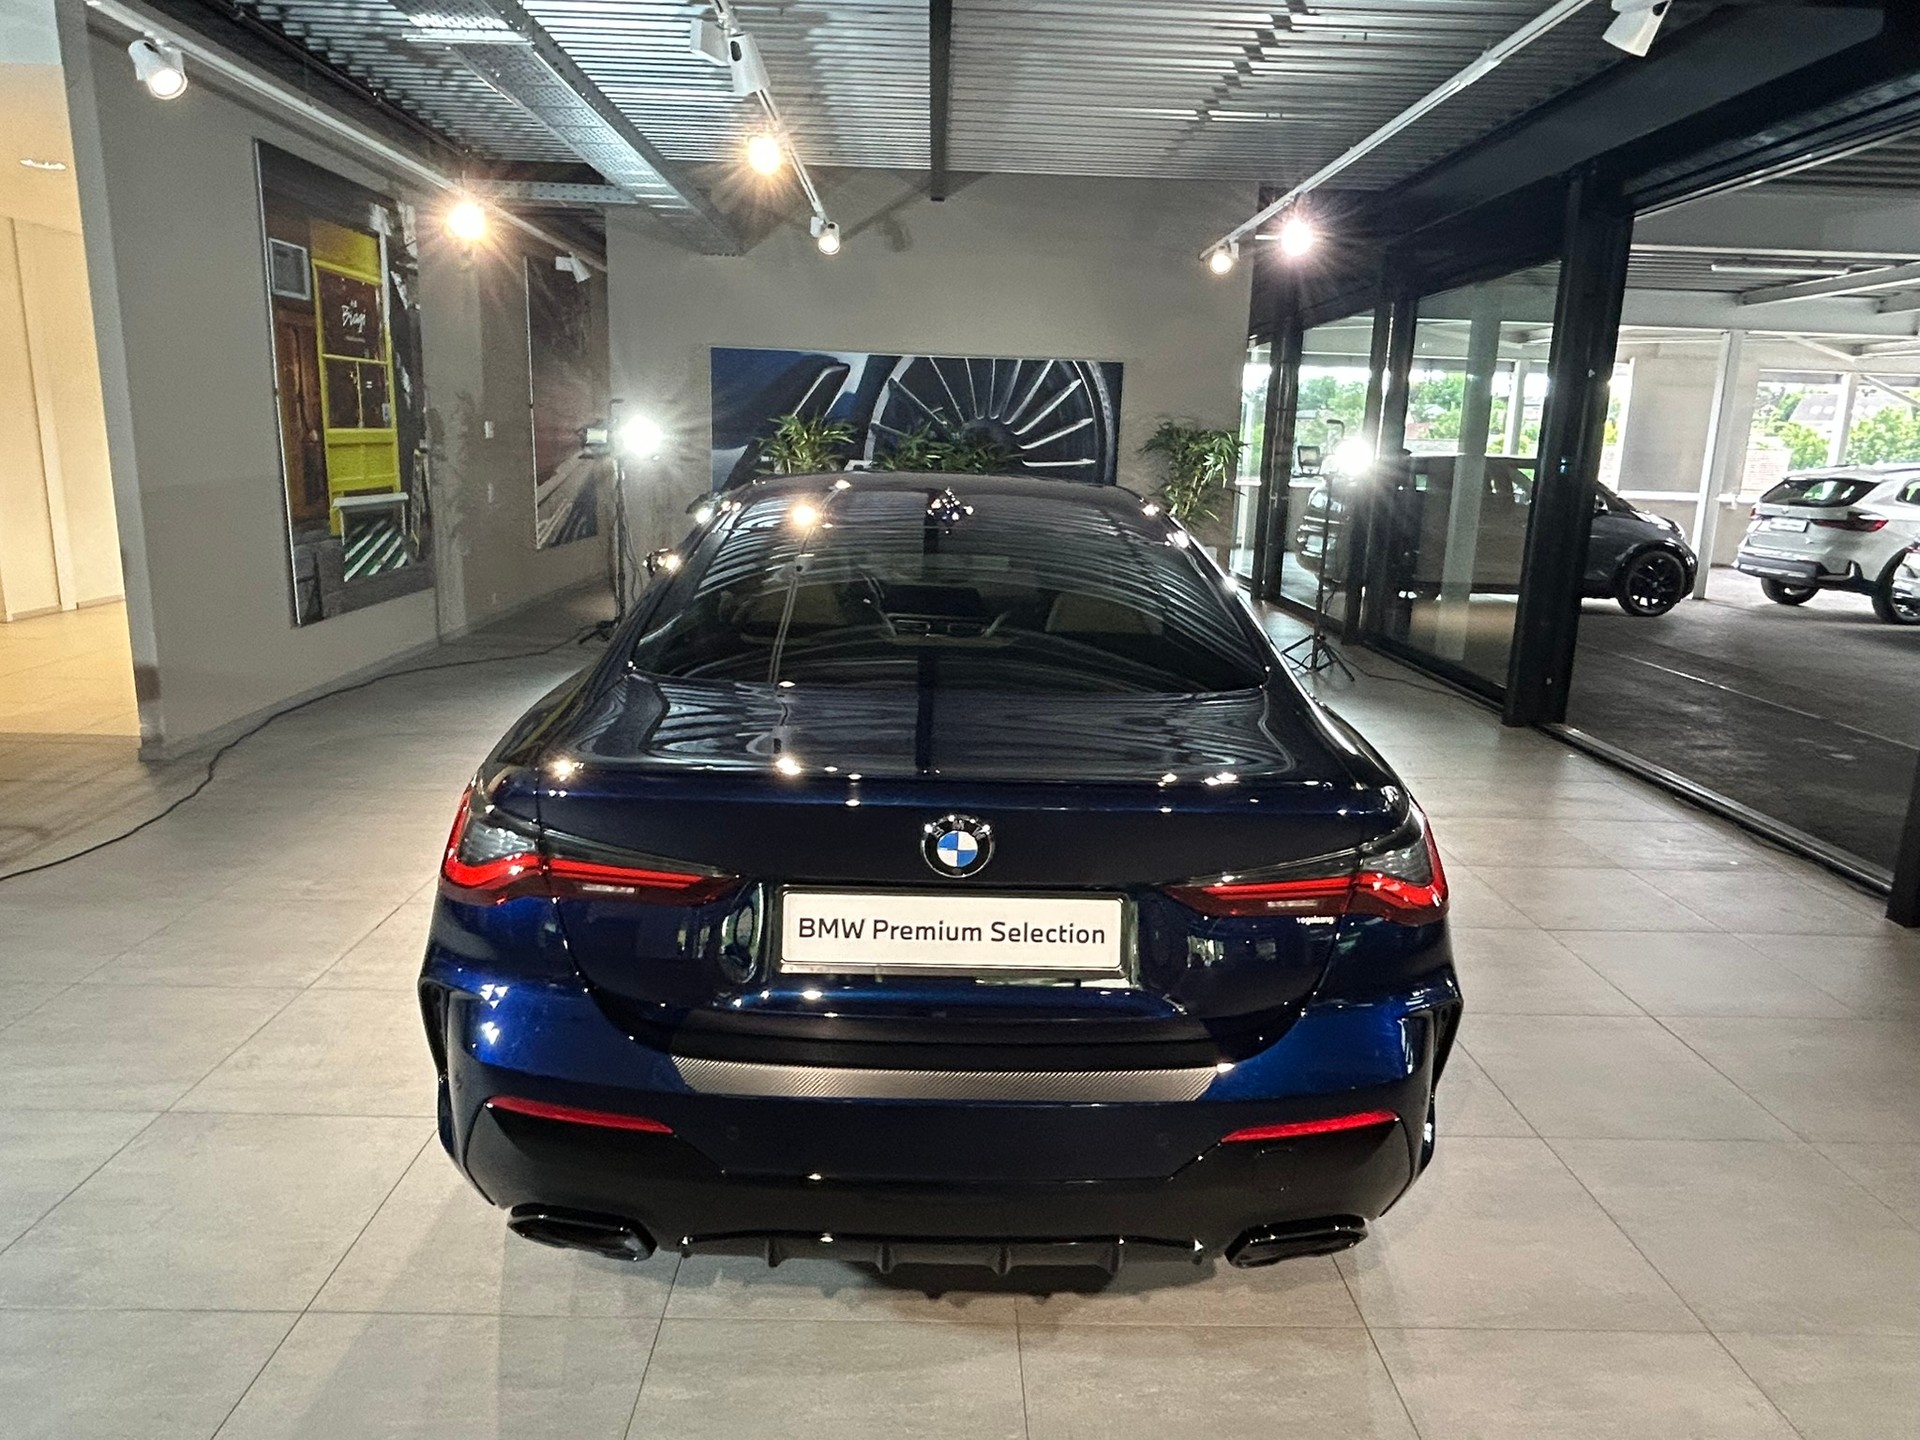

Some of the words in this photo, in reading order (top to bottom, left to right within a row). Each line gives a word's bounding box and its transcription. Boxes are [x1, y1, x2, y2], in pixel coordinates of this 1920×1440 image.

[798, 917, 864, 938] BMW
[873, 919, 981, 941] Premium
[990, 921, 1104, 943] Selection
